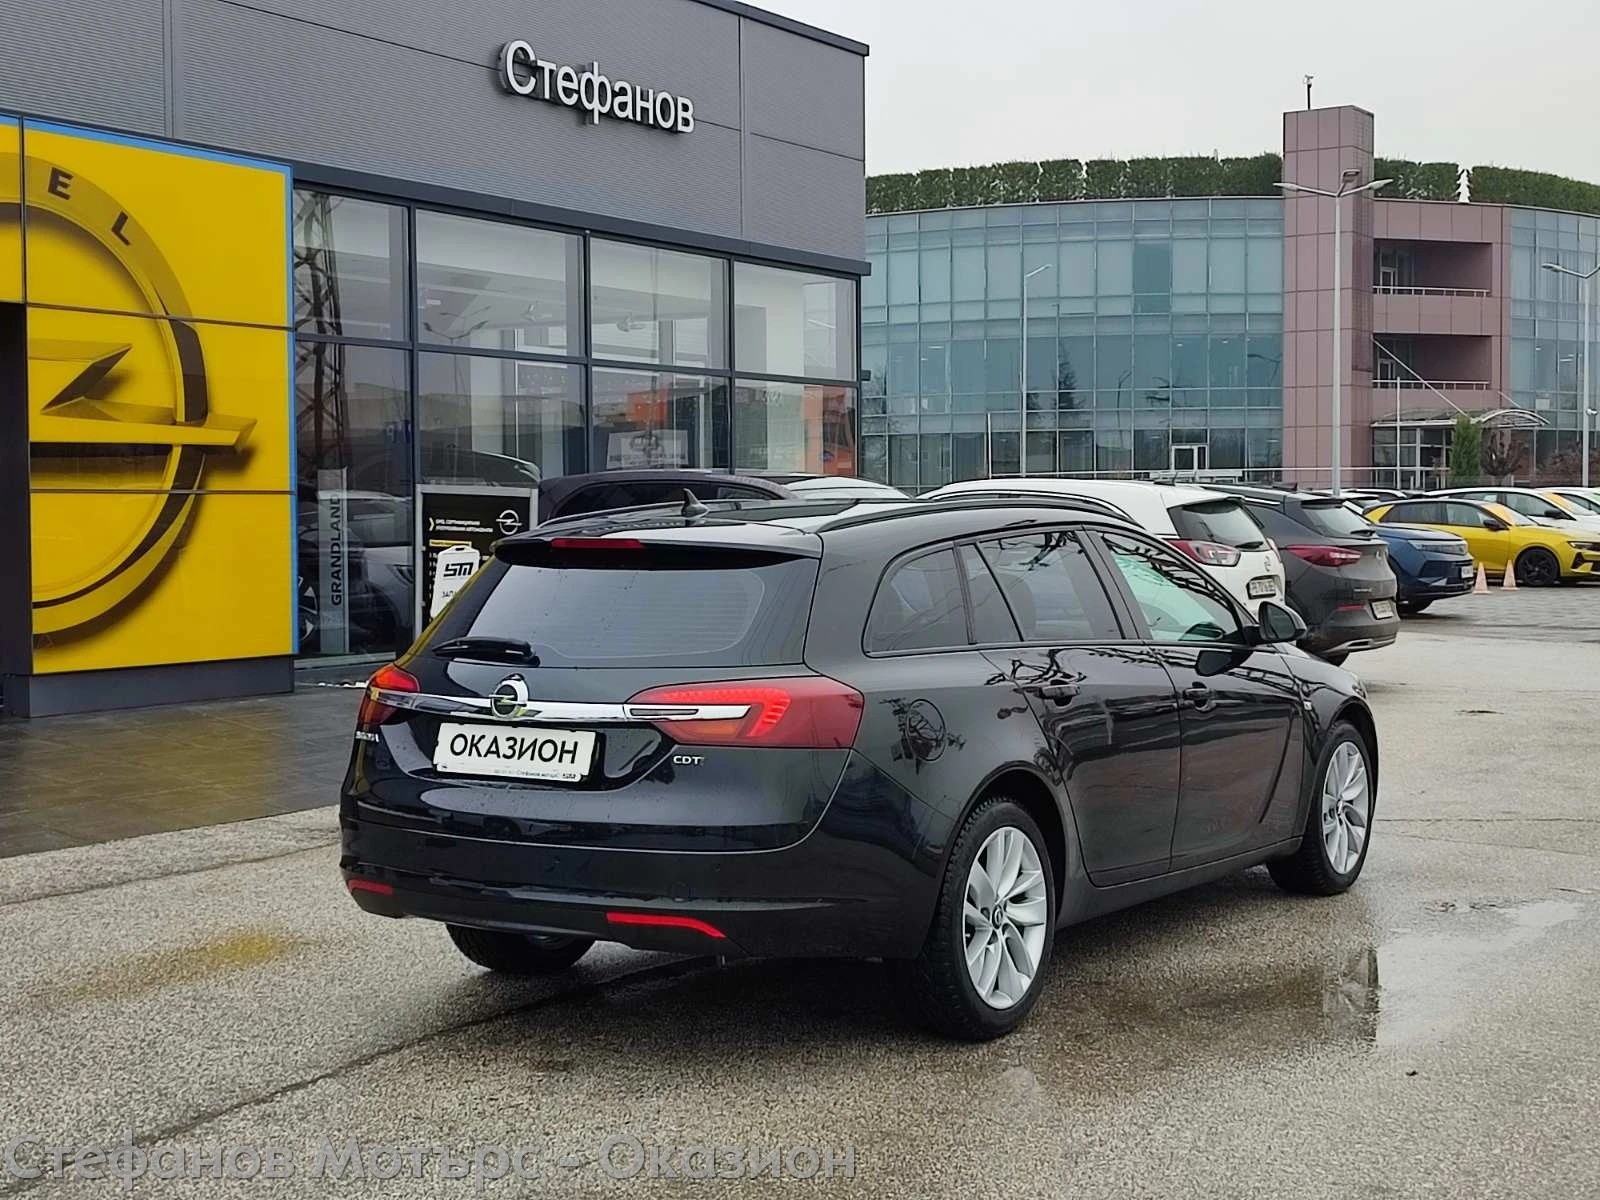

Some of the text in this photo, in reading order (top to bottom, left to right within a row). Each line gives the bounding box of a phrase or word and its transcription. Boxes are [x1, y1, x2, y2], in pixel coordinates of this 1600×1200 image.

[503, 39, 695, 133] Стефанов
[330, 494, 342, 606] GRANDLAND
[449, 732, 579, 764] ОКАЗИОН
